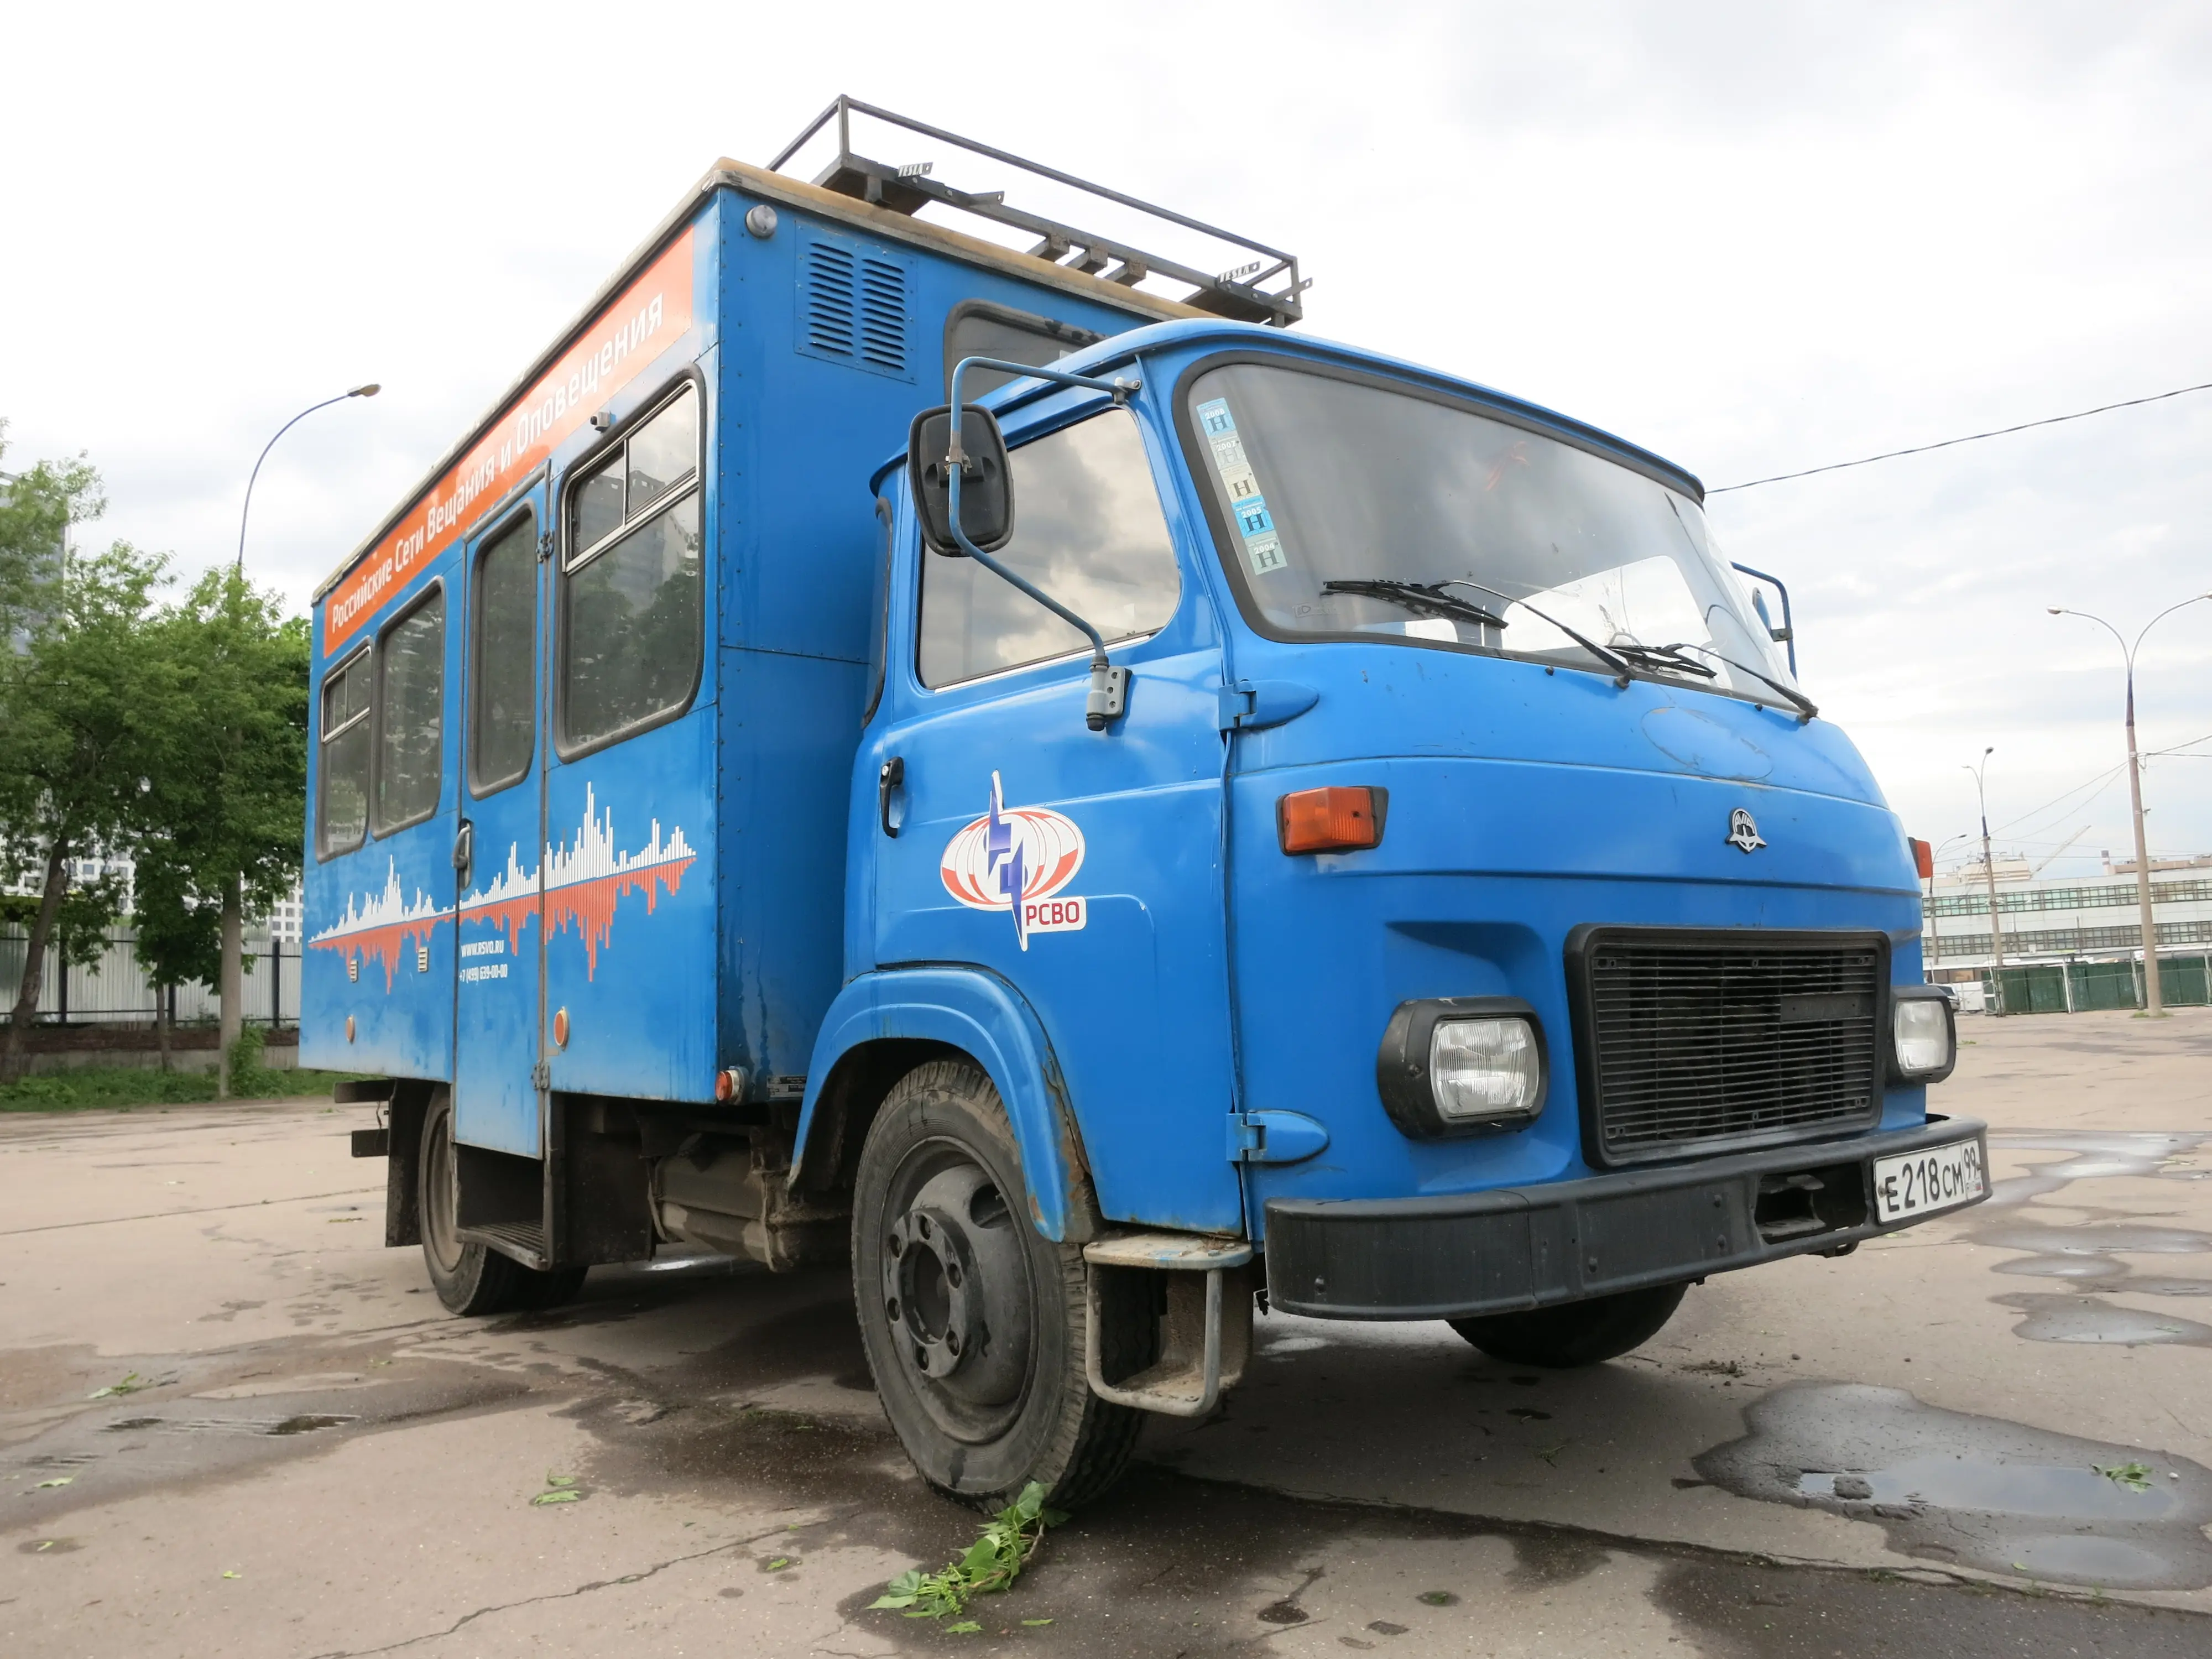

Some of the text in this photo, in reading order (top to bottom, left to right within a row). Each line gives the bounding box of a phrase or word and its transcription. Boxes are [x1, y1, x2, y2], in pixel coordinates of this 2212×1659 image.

[898, 164, 923, 177] TESLA
[1219, 265, 1250, 283] TESLA
[1204, 408, 1225, 420] 2008
[1217, 441, 1236, 452] 2007
[332, 293, 663, 634] Российские Сети Вещания и Оповещения
[1241, 507, 1262, 519] 2005
[1254, 542, 1275, 555] 2004
[1735, 812, 1755, 834] AVIA
[1026, 901, 1080, 926] РСВО
[461, 940, 504, 958] WWW.RSVO.RU
